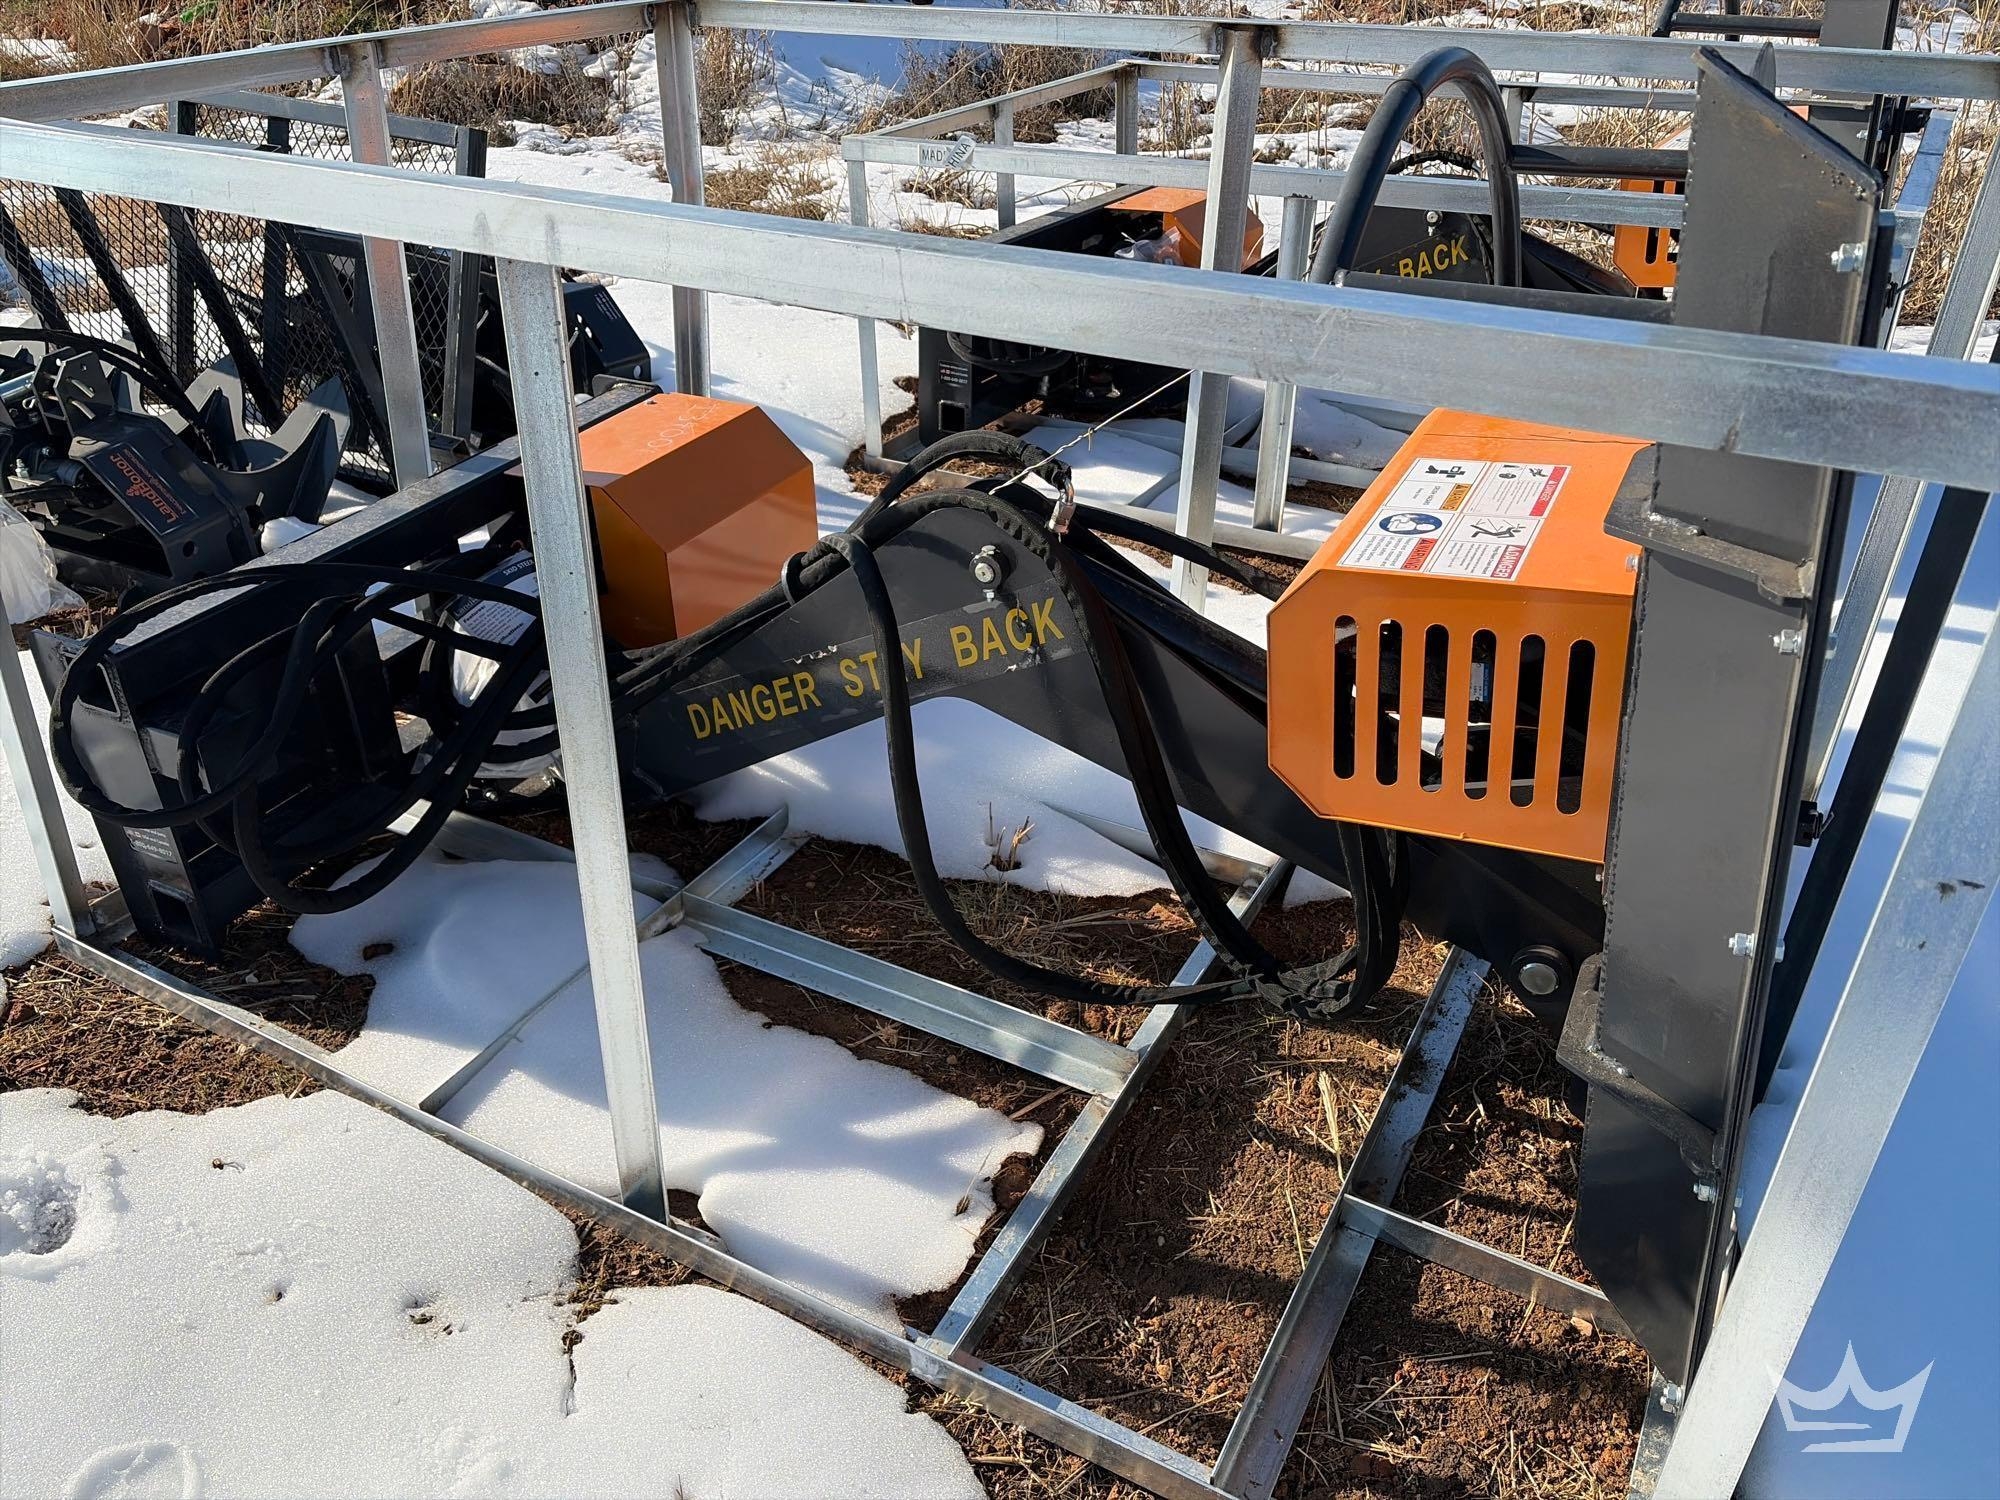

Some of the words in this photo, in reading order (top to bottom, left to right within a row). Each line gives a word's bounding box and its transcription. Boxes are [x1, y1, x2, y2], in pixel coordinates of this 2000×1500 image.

[921, 149, 946, 162] MAD
[945, 143, 971, 168] HINA
[1399, 234, 1469, 279] BACK
[109, 453, 178, 524] LandHonor
[502, 565, 518, 577] SKID
[1403, 545, 1434, 570] WARNING
[1492, 551, 1523, 578] DANGER
[686, 672, 822, 740] DANGER
[838, 638, 924, 698] STY
[949, 597, 1065, 668] BACK
